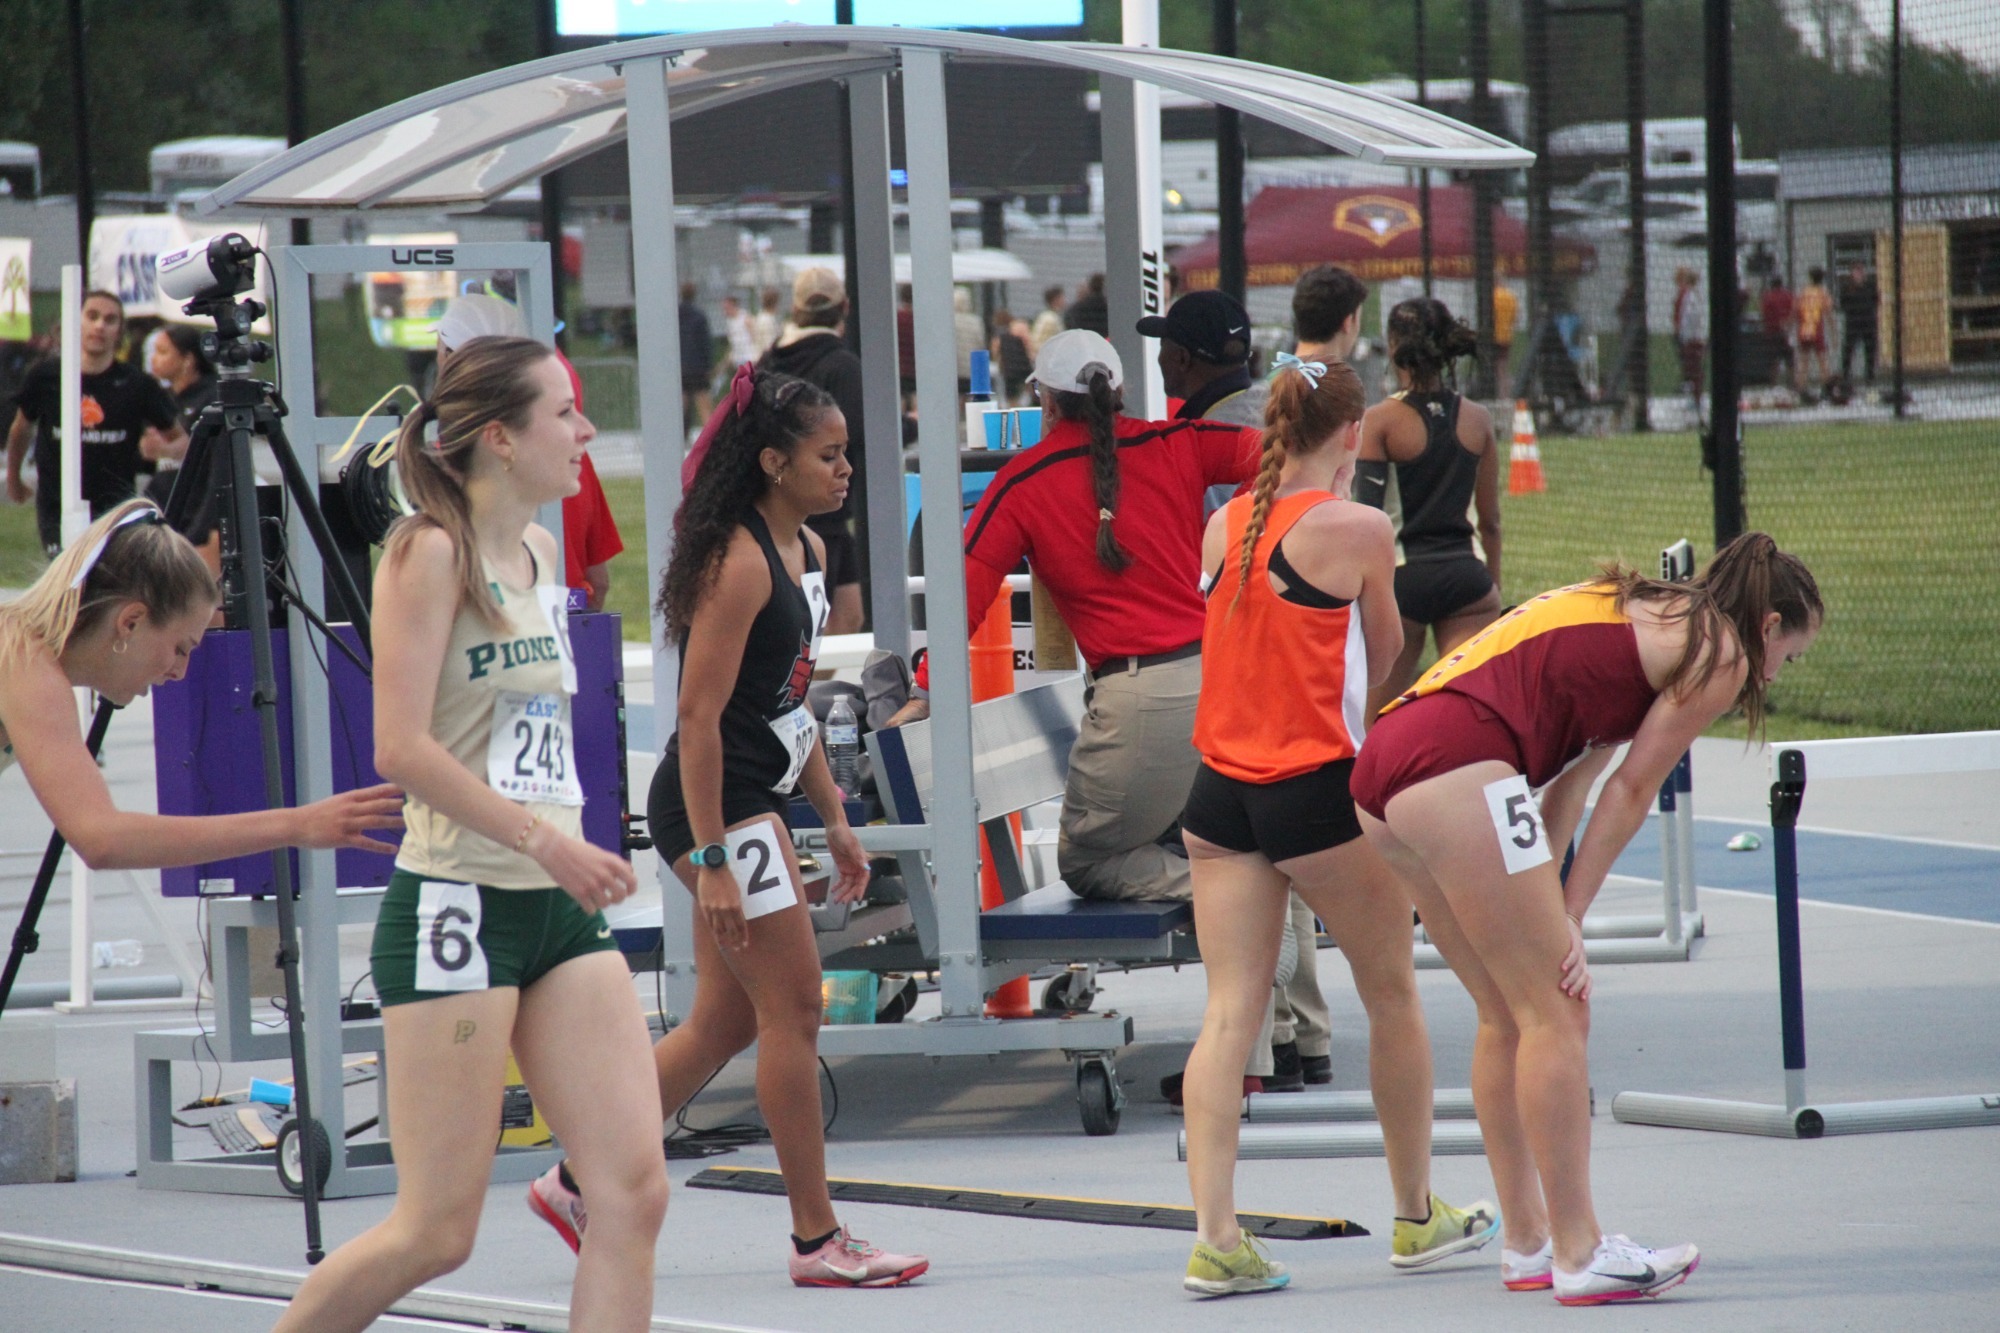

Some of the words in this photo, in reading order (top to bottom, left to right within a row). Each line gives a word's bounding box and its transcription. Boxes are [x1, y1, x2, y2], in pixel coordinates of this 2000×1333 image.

[391, 249, 454, 265] UCS
[1142, 250, 1159, 314] GILL
[465, 636, 560, 682] PIONE
[514, 719, 565, 781] 243
[1505, 793, 1538, 849] 5
[737, 838, 781, 896] 2
[430, 905, 473, 972] 6
